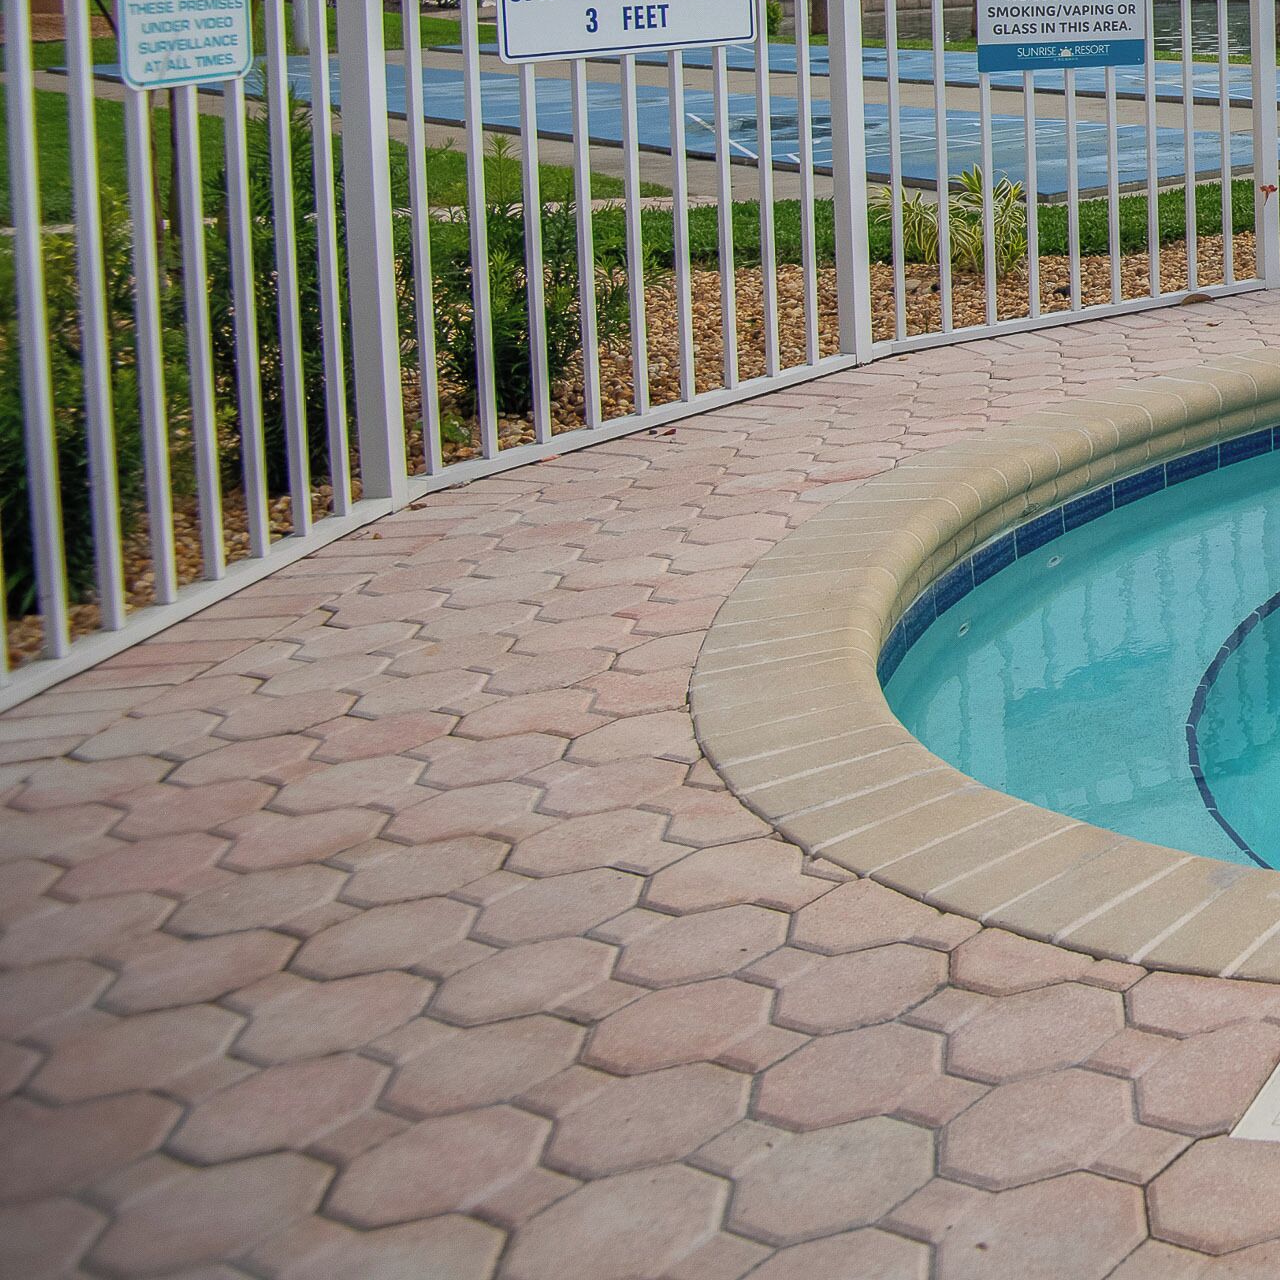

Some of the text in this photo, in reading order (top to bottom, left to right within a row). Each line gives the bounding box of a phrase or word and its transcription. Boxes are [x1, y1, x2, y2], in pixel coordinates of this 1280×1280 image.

[129, 2, 174, 14] THESE
[988, 4, 1135, 18] SMOKING/VAPING OR
[142, 17, 233, 33] UNDER VIDEO
[586, 4, 668, 33] 3 FEET
[993, 21, 1131, 35] GLASS IN THIS AREA.
[139, 35, 238, 54] SURVEILLANCE
[1018, 45, 1110, 57] SUNRISE RESORT
[145, 53, 236, 73] AT ALL TIMES.
